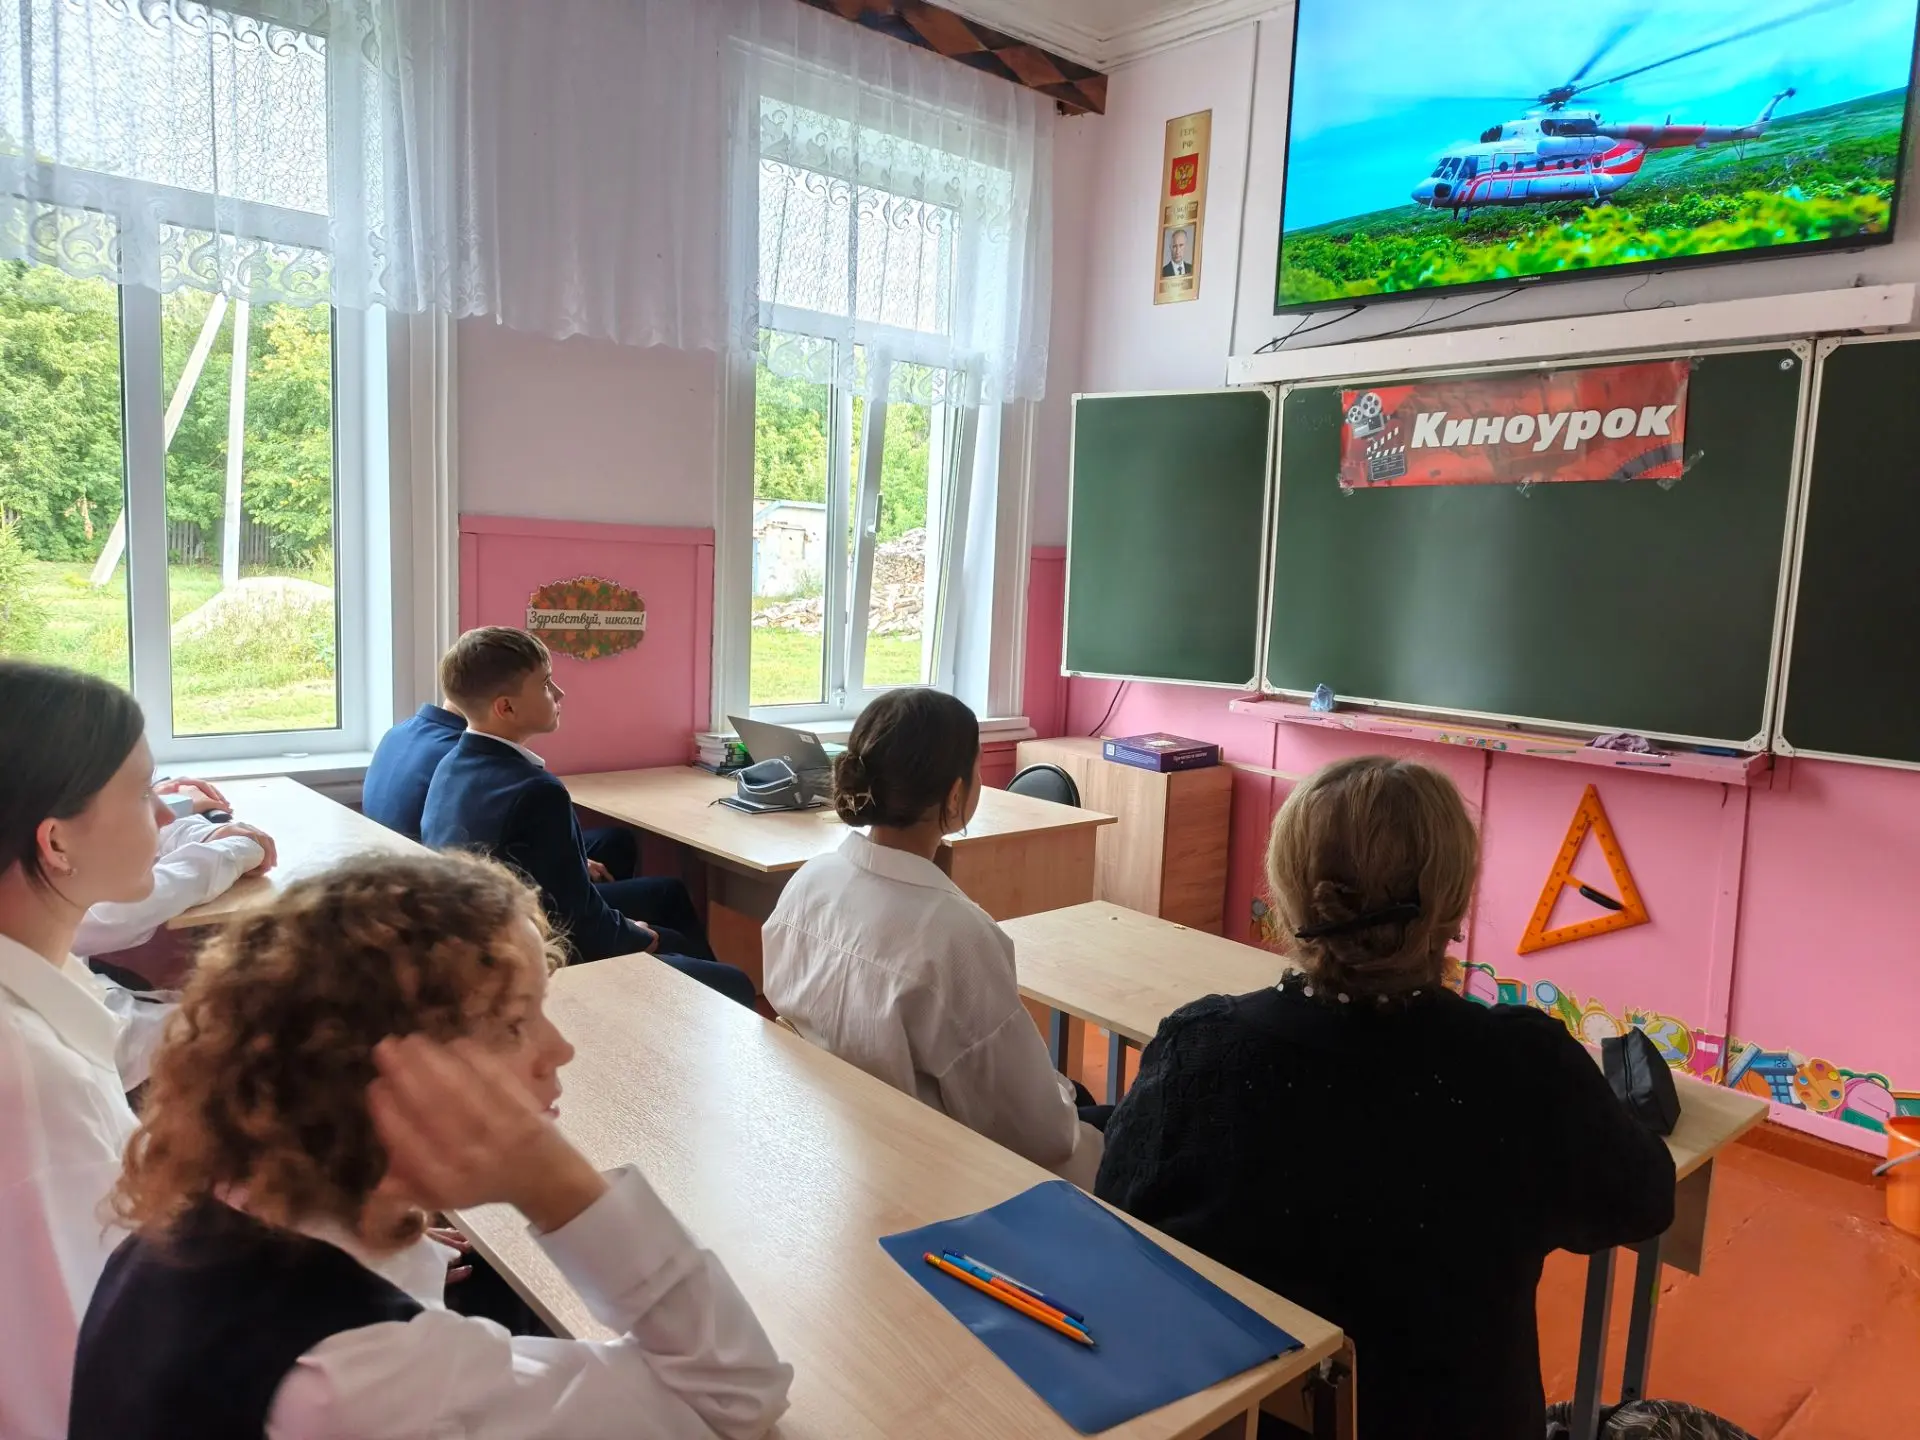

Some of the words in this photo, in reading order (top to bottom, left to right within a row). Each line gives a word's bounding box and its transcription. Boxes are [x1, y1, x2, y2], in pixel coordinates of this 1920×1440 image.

[1411, 405, 1677, 452] Киноурок
[530, 611, 601, 631] Здравствуй,
[605, 613, 645, 626] школа!
